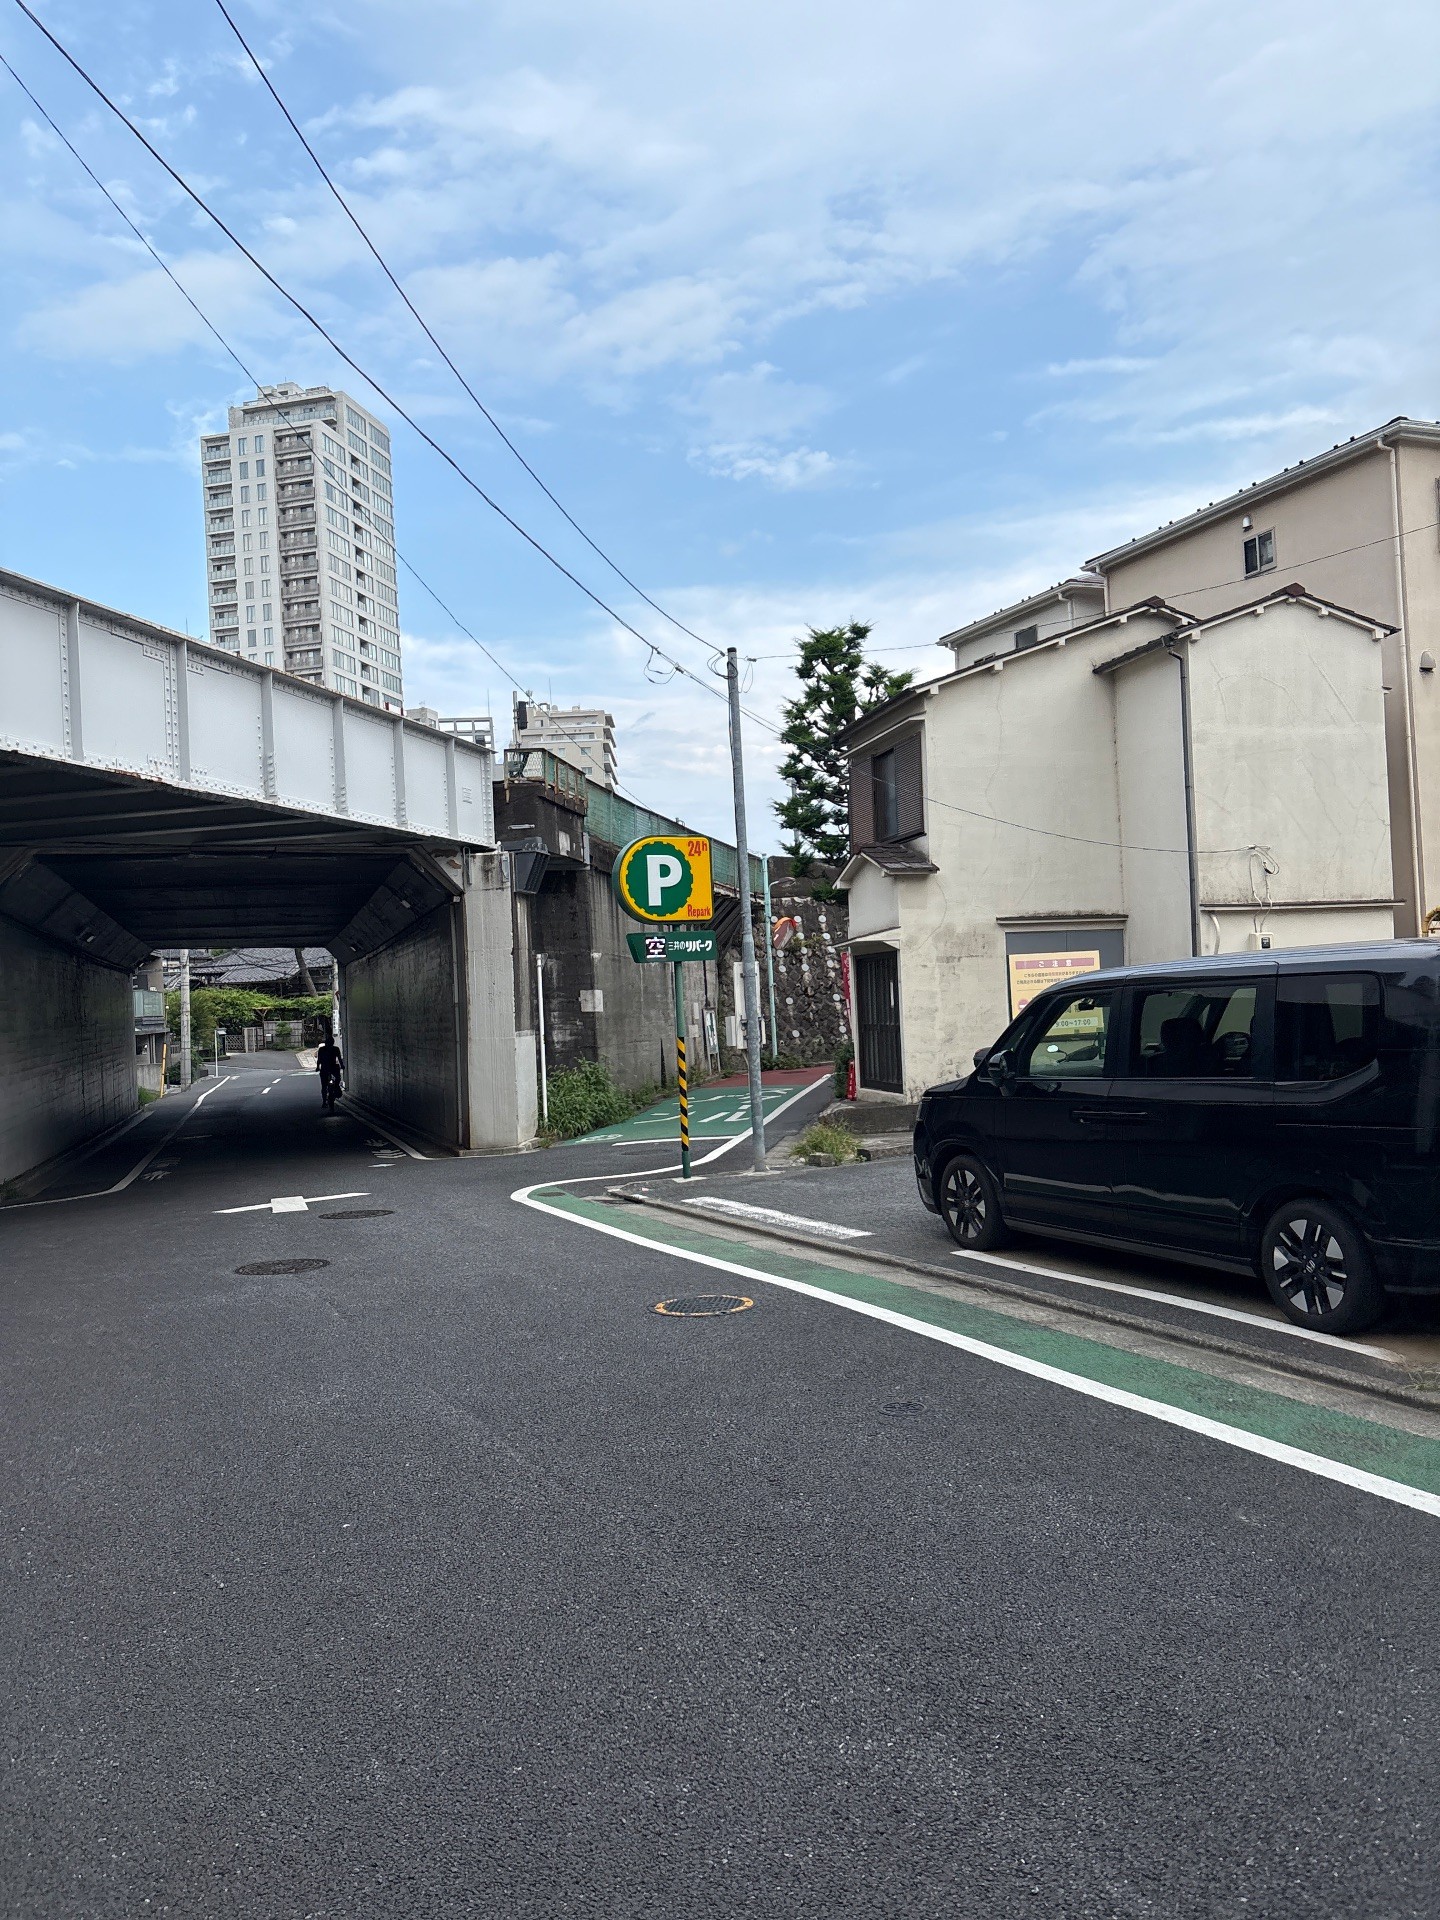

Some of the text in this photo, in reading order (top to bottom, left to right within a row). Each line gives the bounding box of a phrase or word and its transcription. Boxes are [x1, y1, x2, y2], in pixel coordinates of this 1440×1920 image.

[687, 840, 708, 857] 24h
[646, 854, 683, 907] P
[687, 904, 711, 918] Repark
[668, 939, 713, 953] 三井のリパーク
